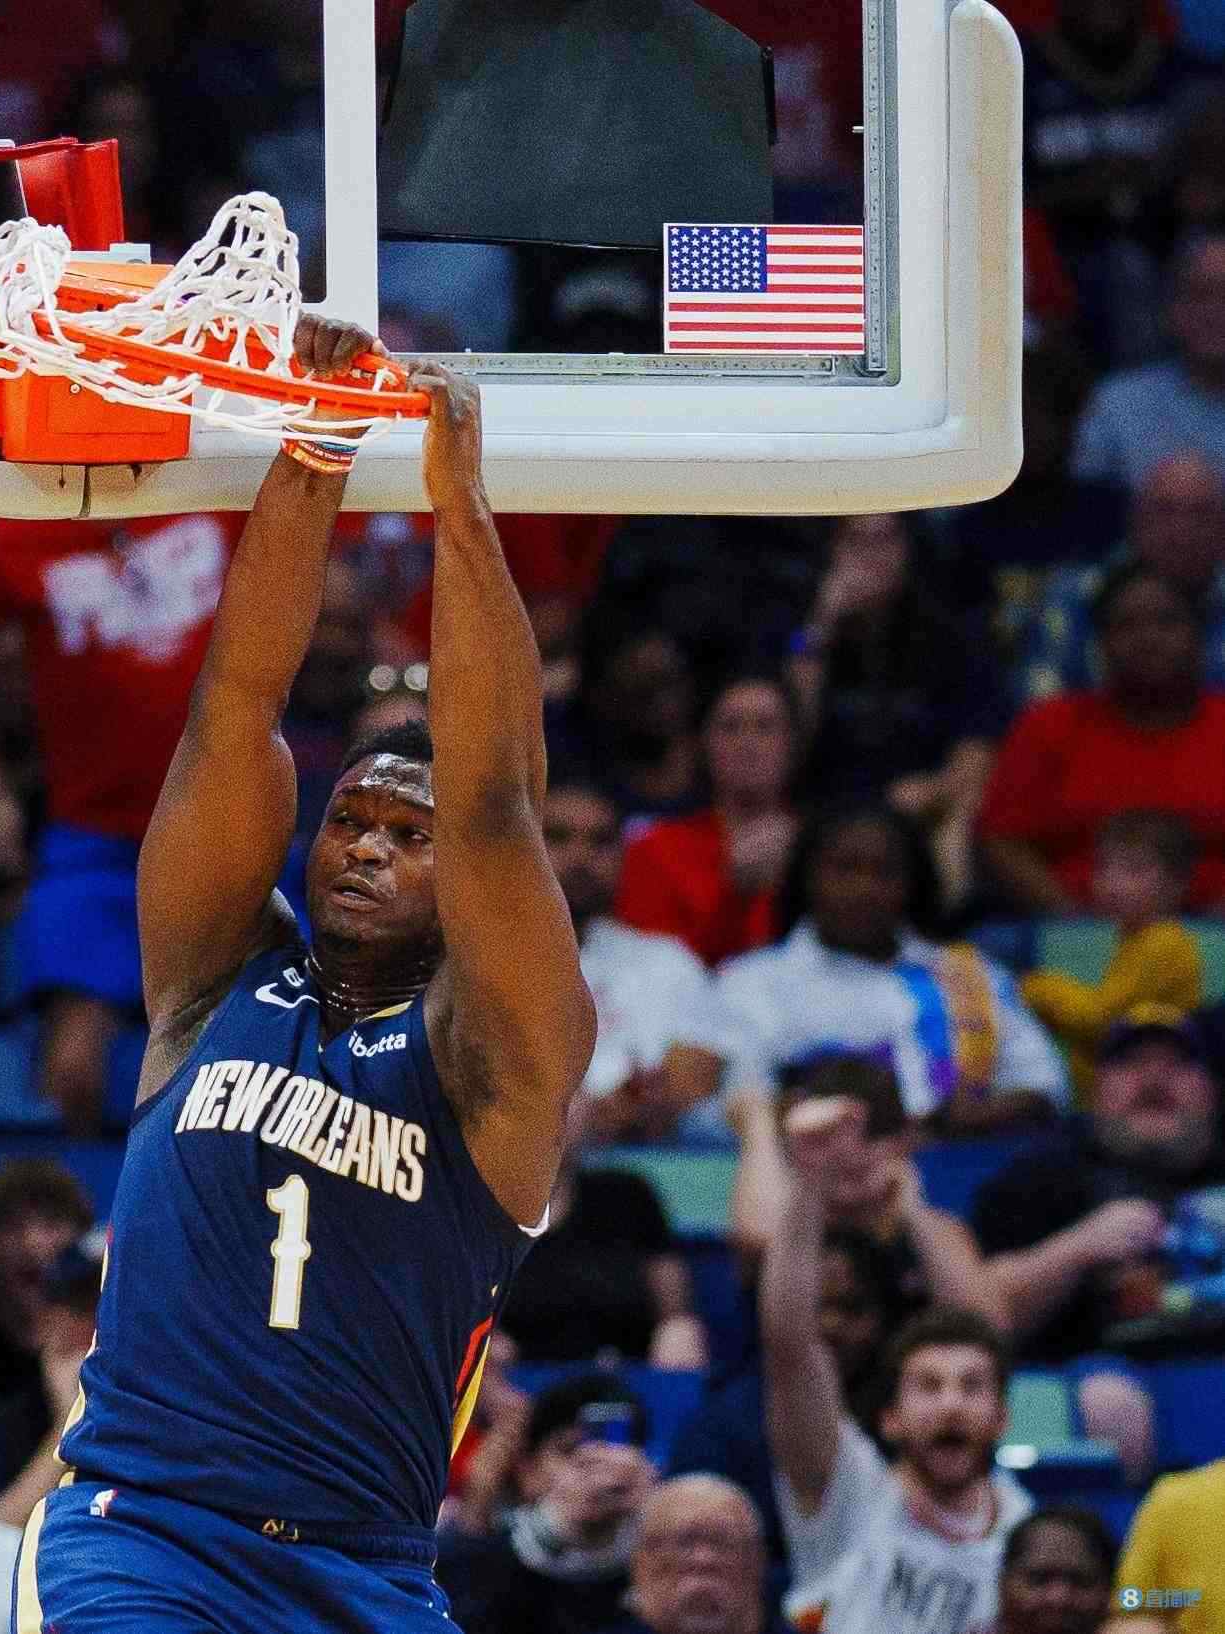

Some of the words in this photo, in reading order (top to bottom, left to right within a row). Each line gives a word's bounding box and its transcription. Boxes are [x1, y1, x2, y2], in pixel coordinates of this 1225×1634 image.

[348, 1030, 407, 1058] ibotta
[175, 1060, 290, 1134] NEW
[260, 1076, 426, 1202] ORLEANS
[266, 1174, 312, 1329] 1
